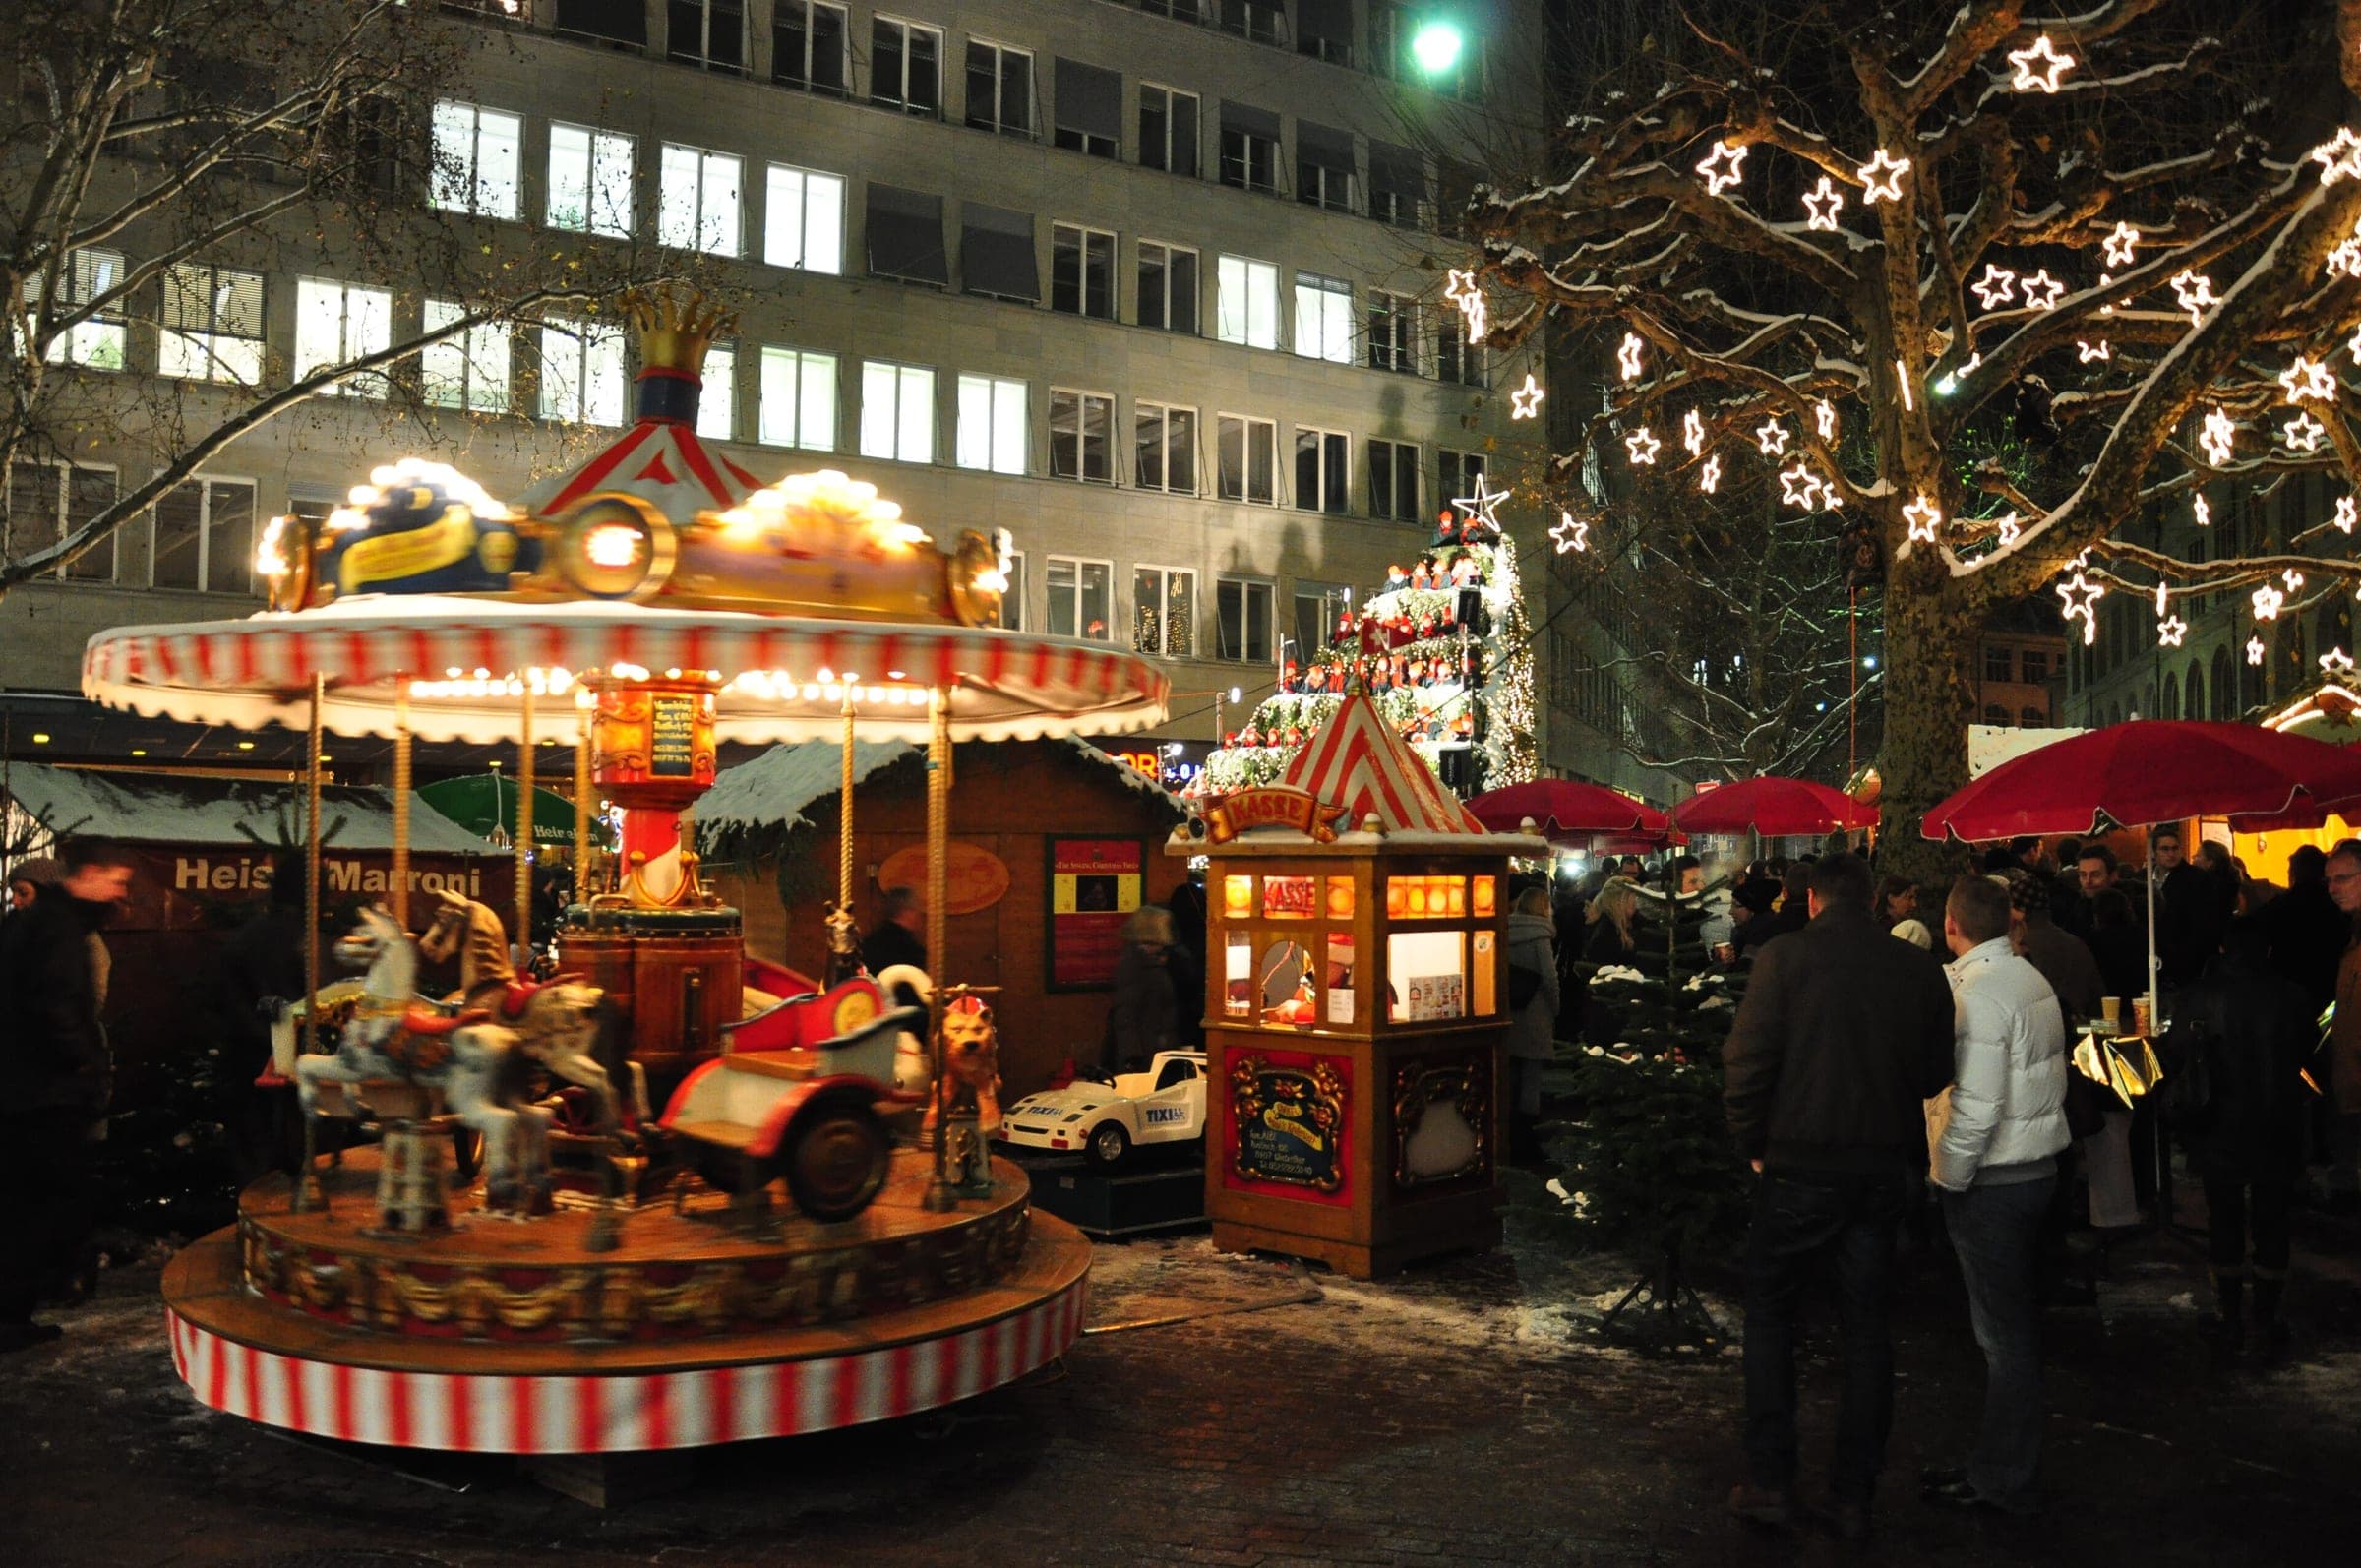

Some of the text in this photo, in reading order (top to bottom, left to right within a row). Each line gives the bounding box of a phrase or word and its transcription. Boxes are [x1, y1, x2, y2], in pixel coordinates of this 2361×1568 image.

[1231, 794, 1302, 820] KASSE
[175, 858, 480, 897] Heis Marroni
[1263, 881, 1315, 910] KASSE
[1145, 1108, 1173, 1122] TIXI
